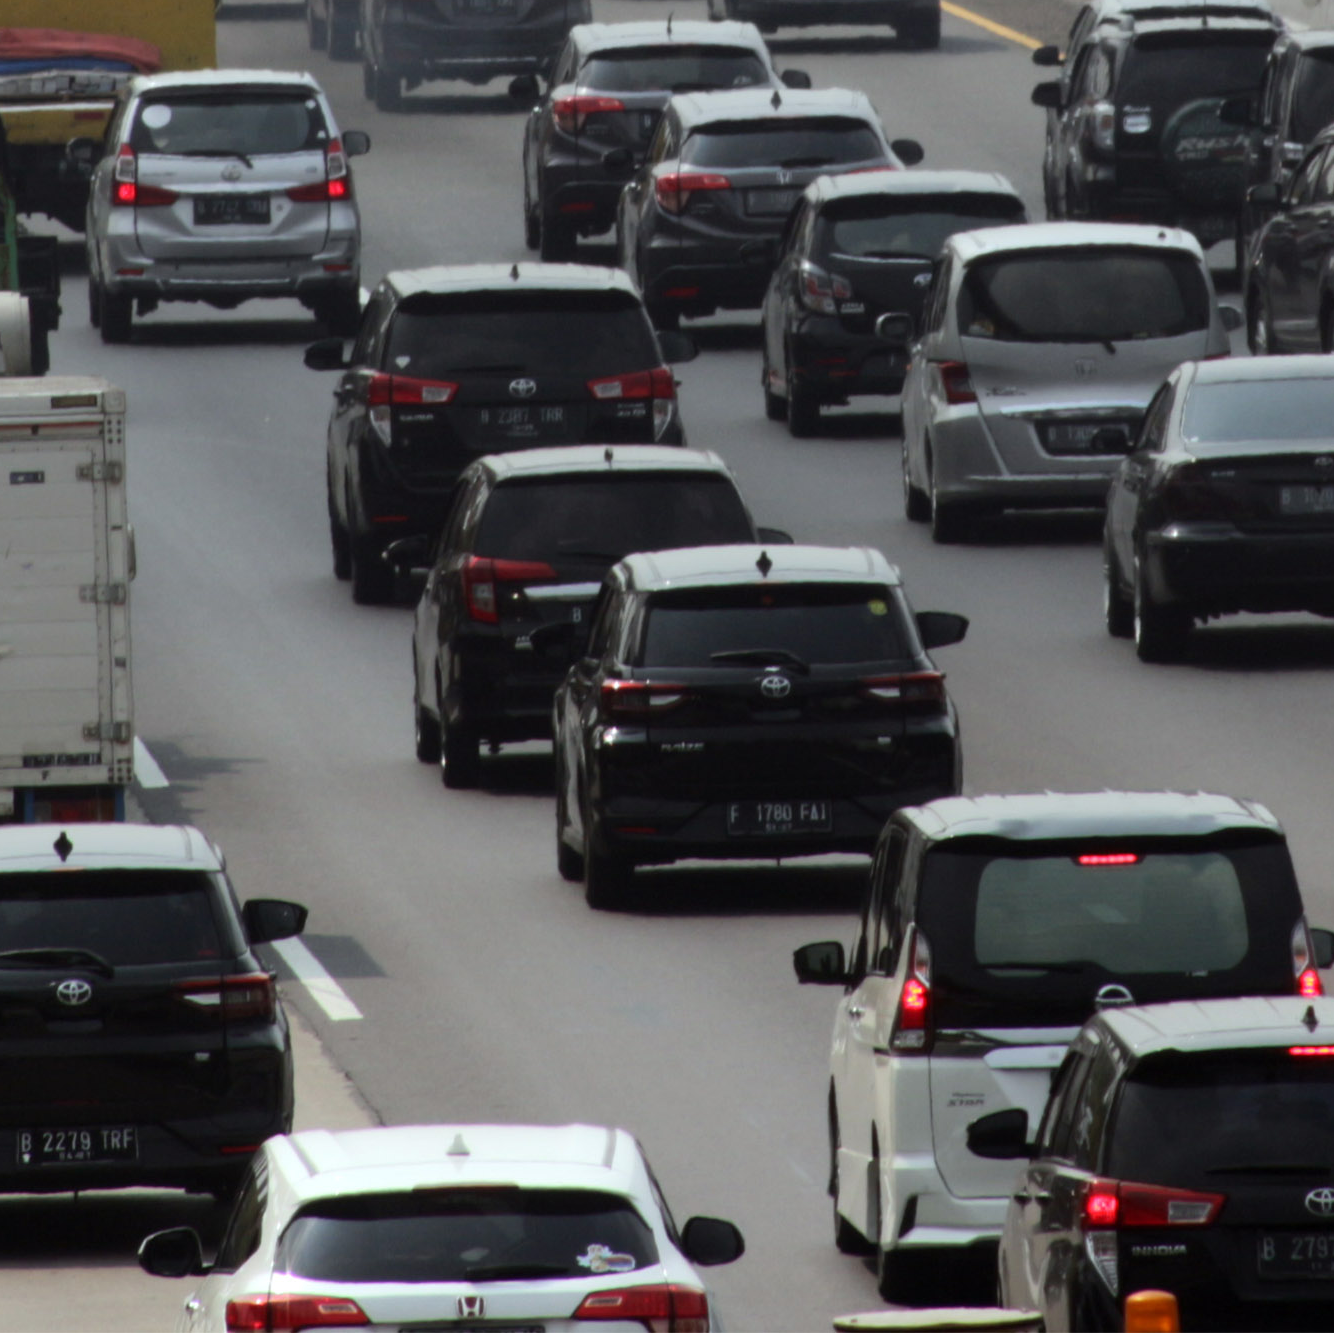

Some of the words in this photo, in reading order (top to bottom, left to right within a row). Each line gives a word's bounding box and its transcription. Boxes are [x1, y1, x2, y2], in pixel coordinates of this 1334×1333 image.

[730, 804, 739, 823] F
[757, 802, 792, 822] 1780
[21, 1131, 33, 1153] B
[43, 1130, 91, 1153] 2279
[100, 1128, 134, 1150] TRF
[1263, 1235, 1275, 1261] B
